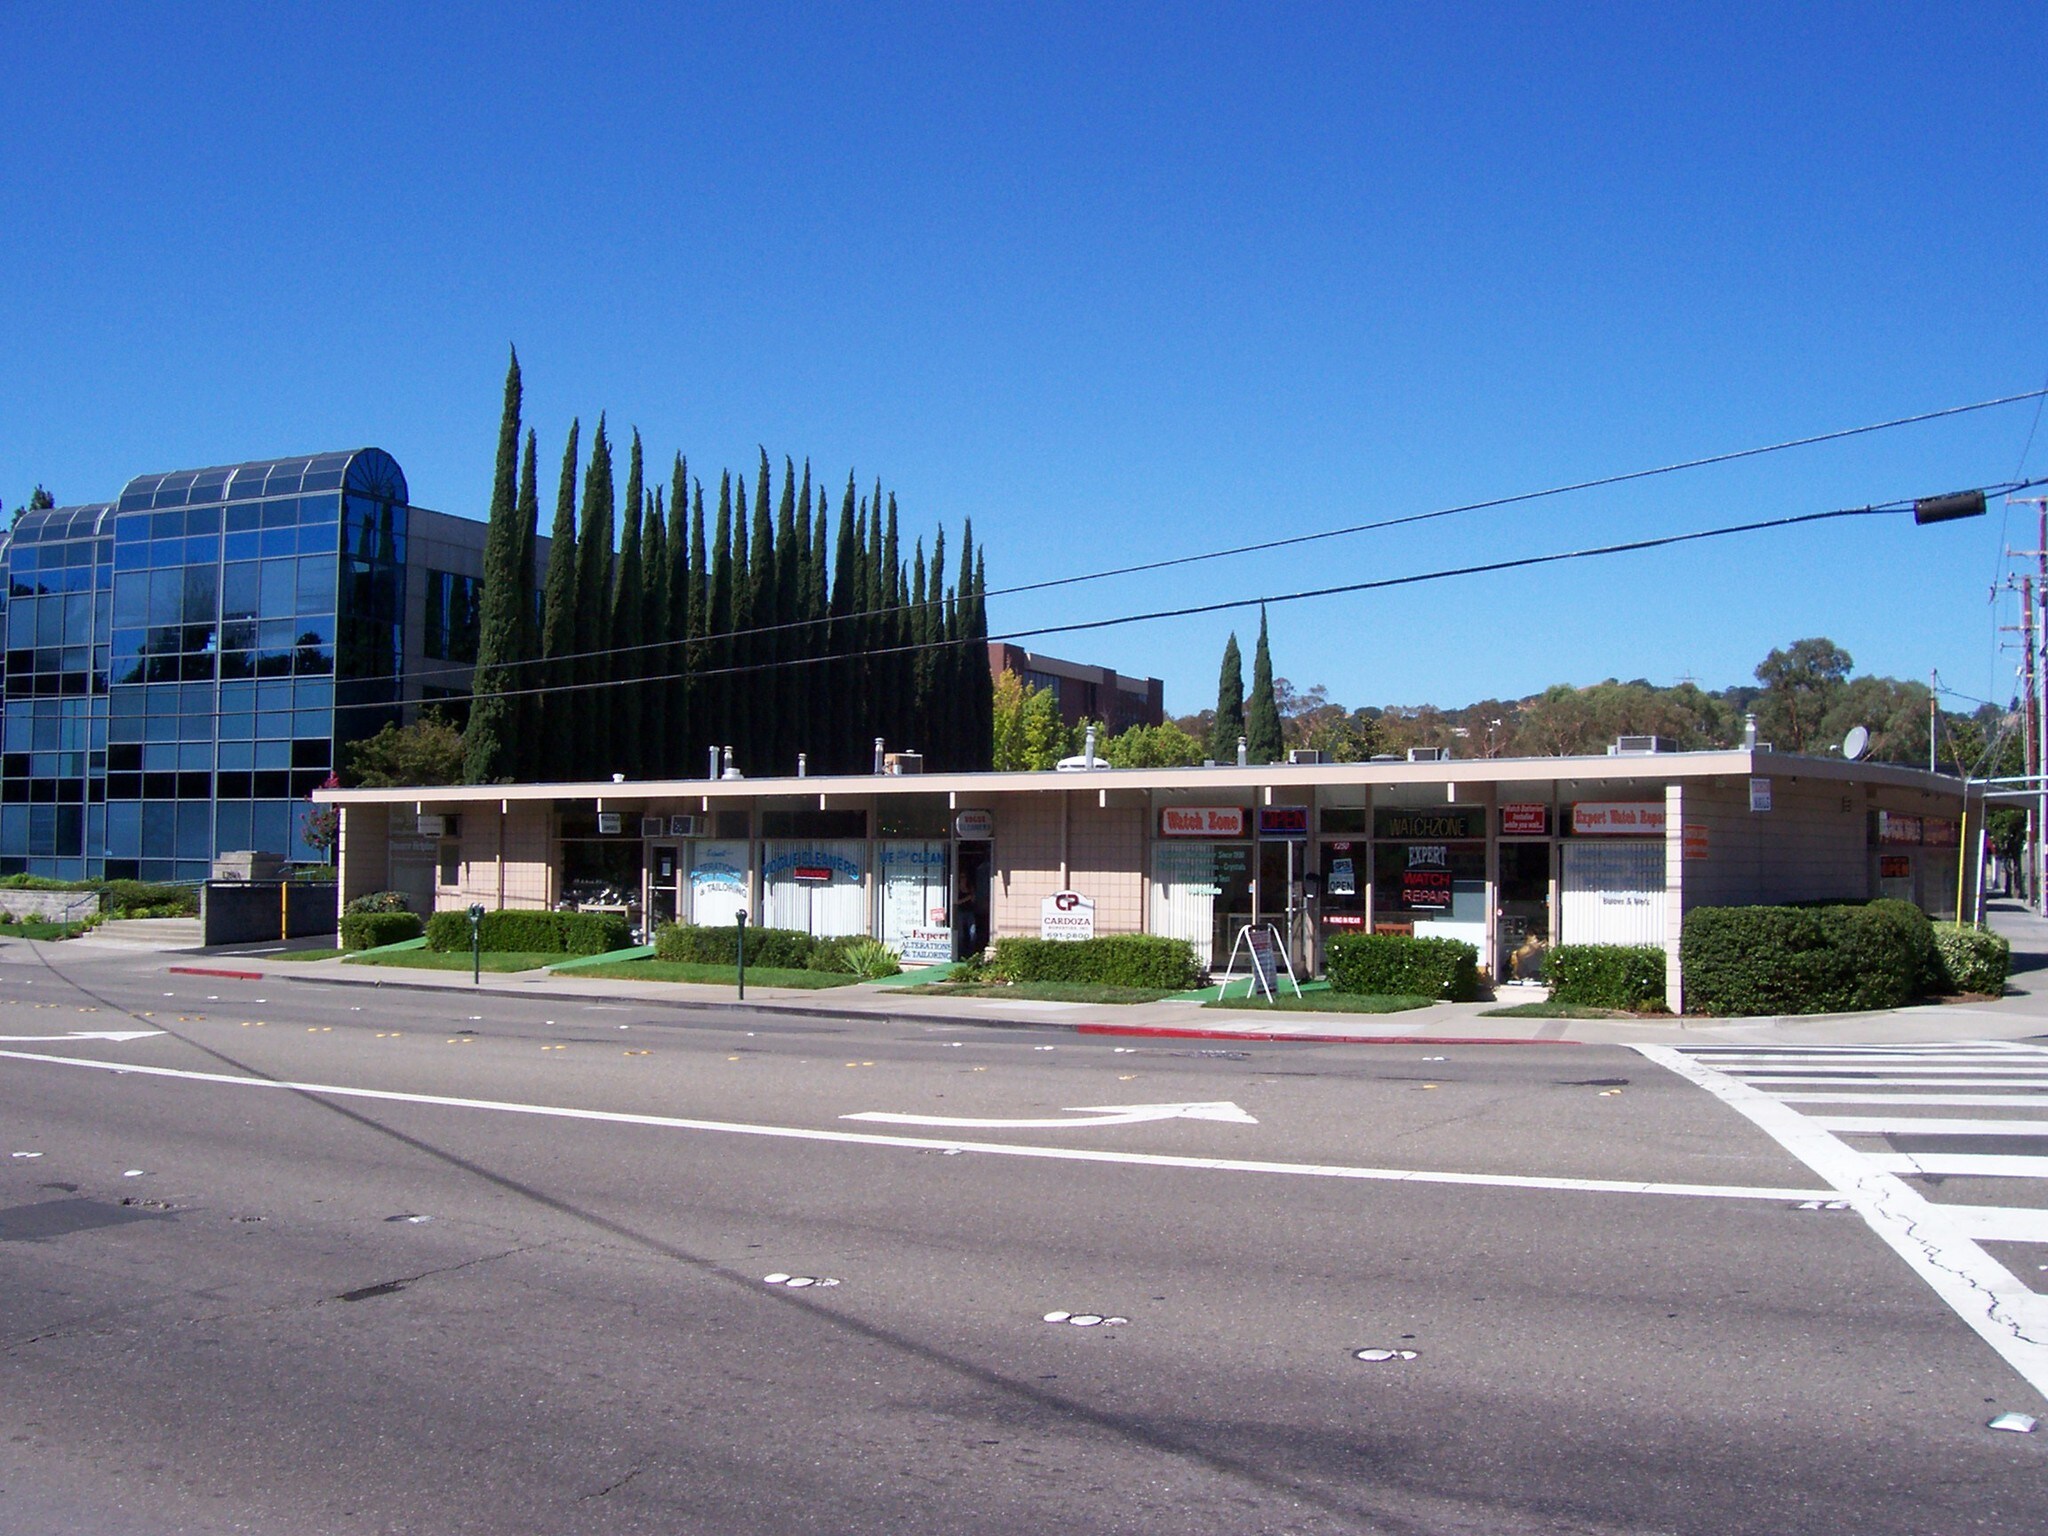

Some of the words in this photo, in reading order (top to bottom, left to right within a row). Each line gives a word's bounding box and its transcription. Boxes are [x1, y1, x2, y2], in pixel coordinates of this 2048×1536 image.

[964, 815, 986, 823] VOGUE
[1167, 811, 1204, 830] Watch
[1208, 811, 1239, 830] Zone
[1262, 809, 1306, 829] OPEN
[1576, 810, 1607, 828] Expert
[1610, 809, 1636, 824] Watch
[1391, 818, 1464, 836] WATCHZONE
[880, 852, 894, 863] WE
[911, 852, 944, 863] CLEAN
[1408, 846, 1446, 867] EXPERT
[762, 852, 799, 878] VOGUE
[802, 851, 859, 880] CLEANERS
[1330, 881, 1353, 891] OPEN
[1404, 873, 1450, 886] WATCH
[707, 883, 748, 898] TAILORING
[1403, 890, 1450, 903] REPAIR
[1055, 894, 1079, 911] CP
[1043, 917, 1091, 926] CARDOZA
[912, 929, 949, 941] Expert
[901, 941, 951, 949] ALTERATIONS
[912, 950, 951, 959] TAILORING
